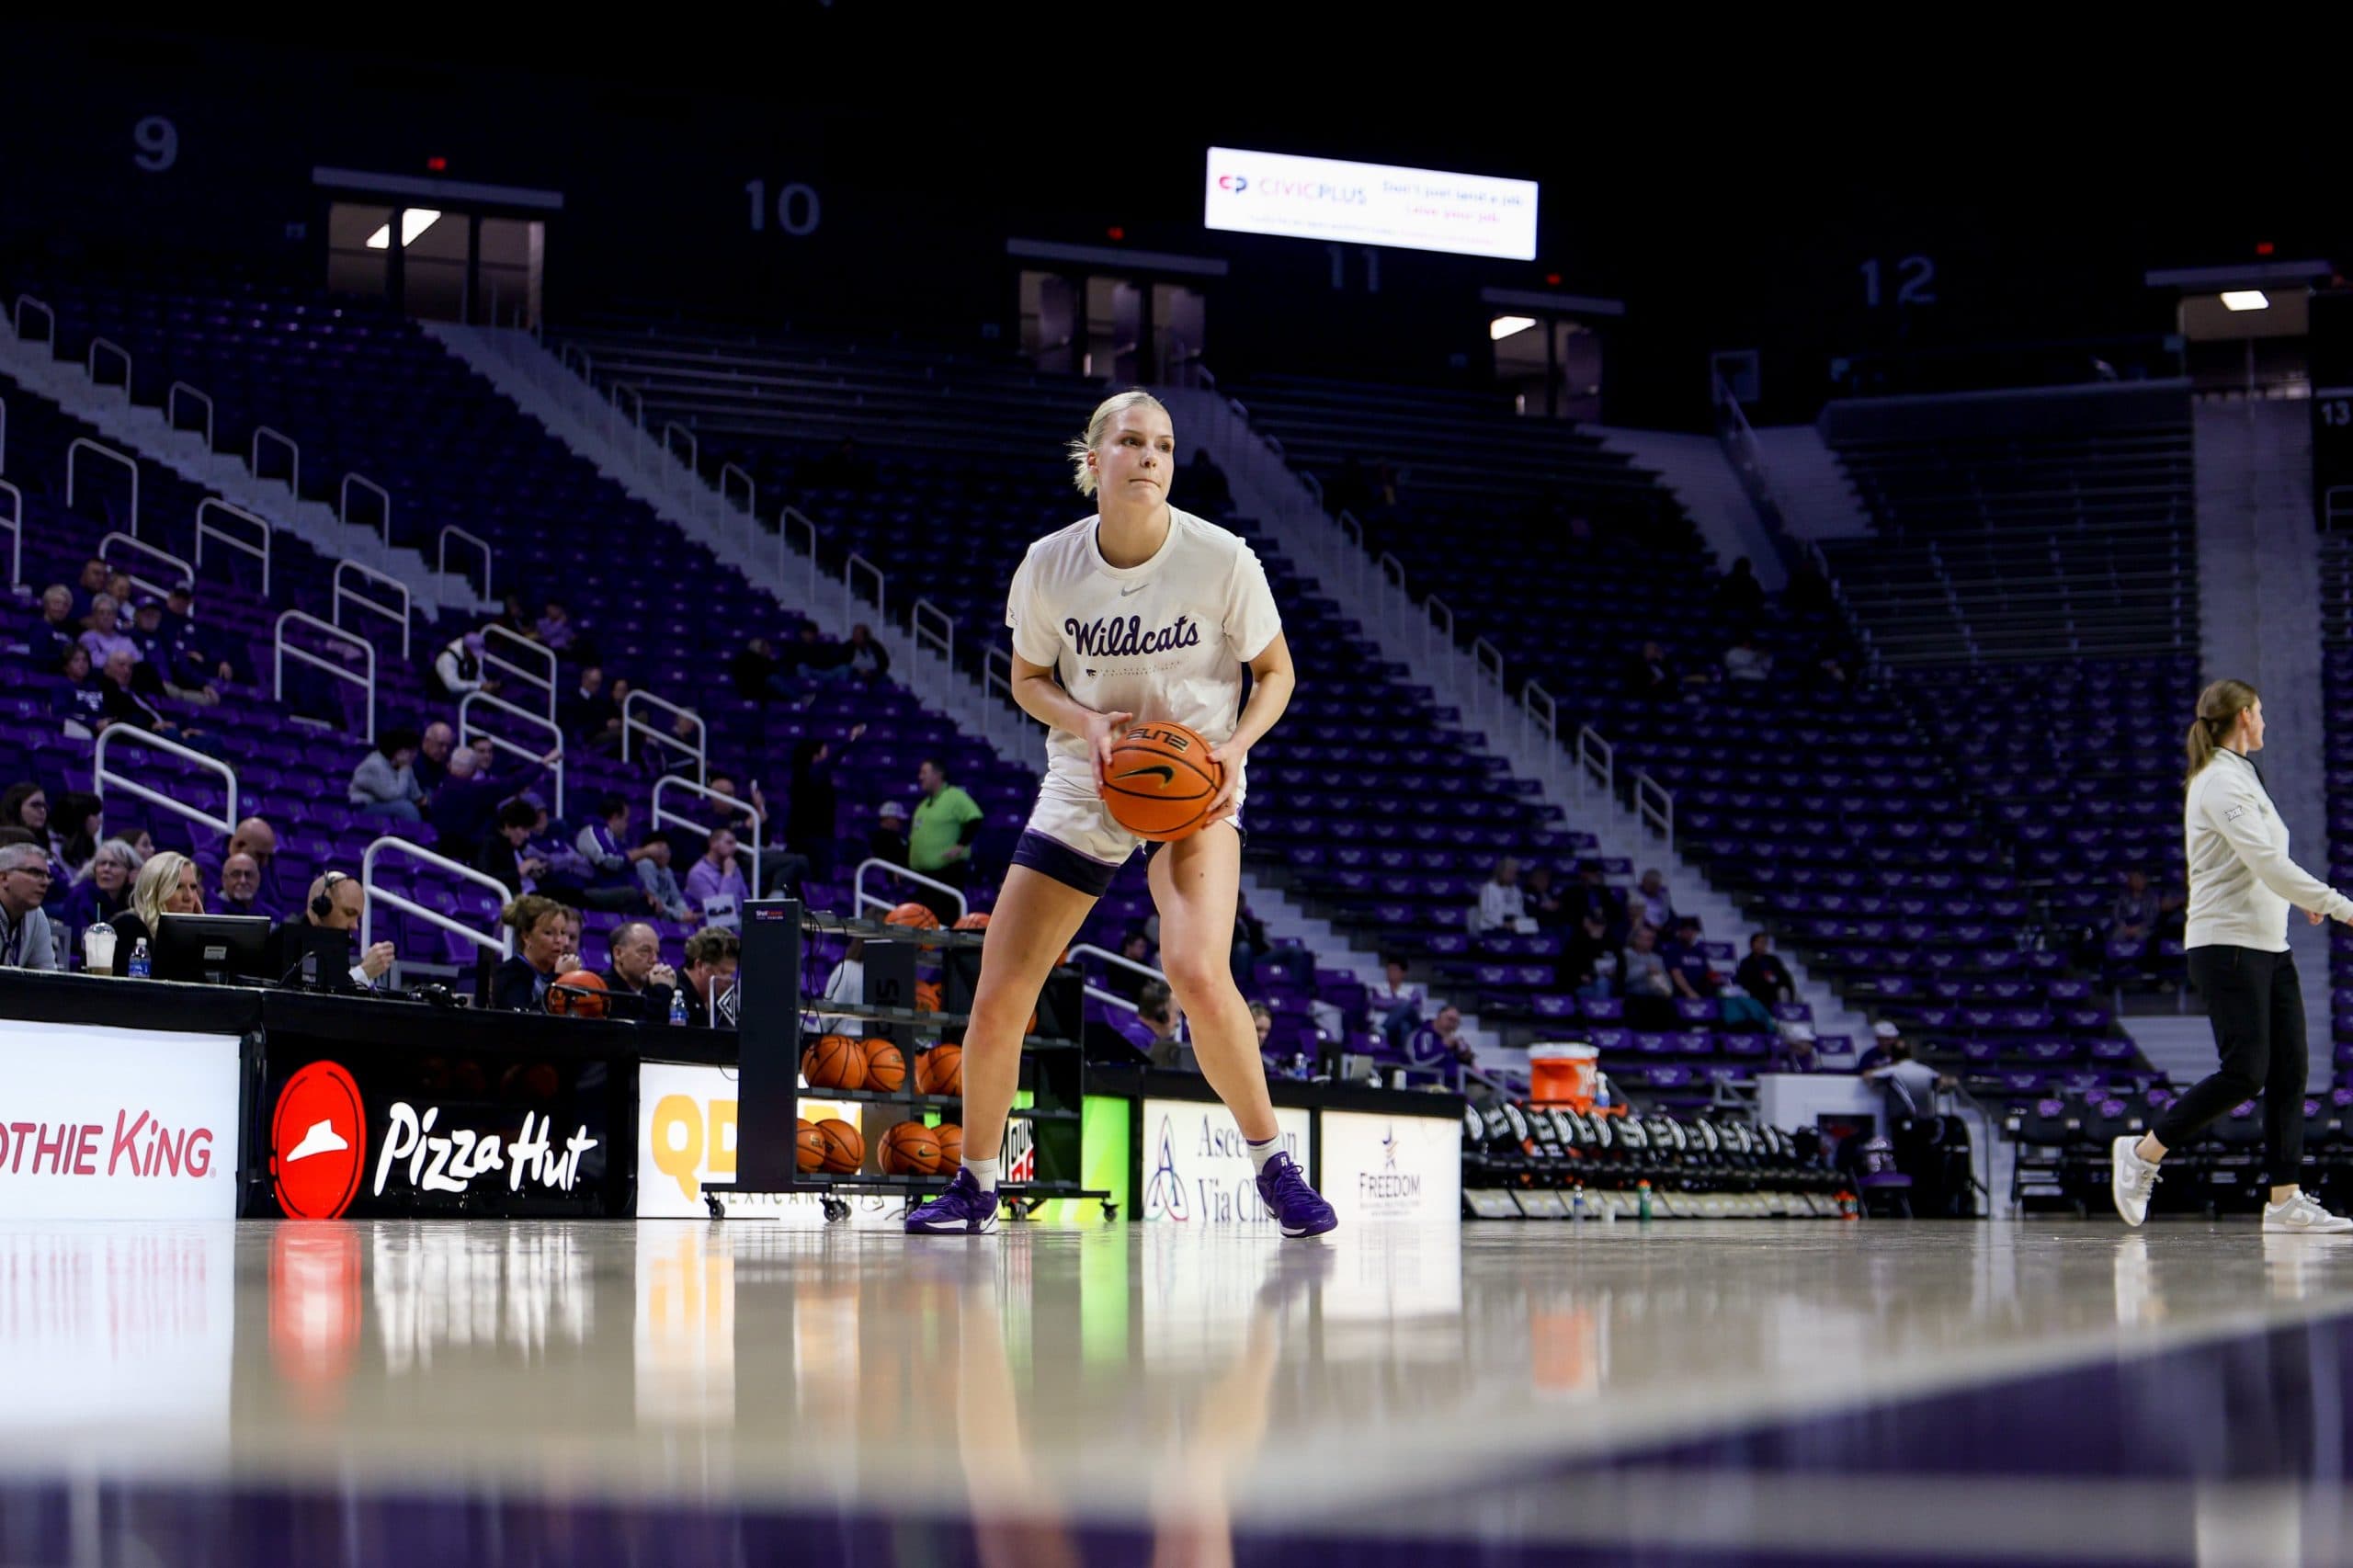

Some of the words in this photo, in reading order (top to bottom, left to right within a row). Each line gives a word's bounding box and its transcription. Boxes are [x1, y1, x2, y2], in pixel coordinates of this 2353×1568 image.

[134, 117, 177, 172] 9
[745, 180, 820, 236] 10
[1324, 244, 1381, 293] 11
[1860, 255, 1936, 306] 12
[2322, 401, 2350, 425] 13
[1065, 615, 1200, 656] Wildcats
[1126, 727, 1189, 752] ELITE
[373, 1101, 505, 1198] Pizza
[507, 1109, 598, 1192] Hut
[1198, 1113, 1297, 1158] Ascen
[715, 1192, 815, 1205] EXICAN
[1198, 1177, 1231, 1222] Via
[1359, 1172, 1421, 1199] FREEDOM
